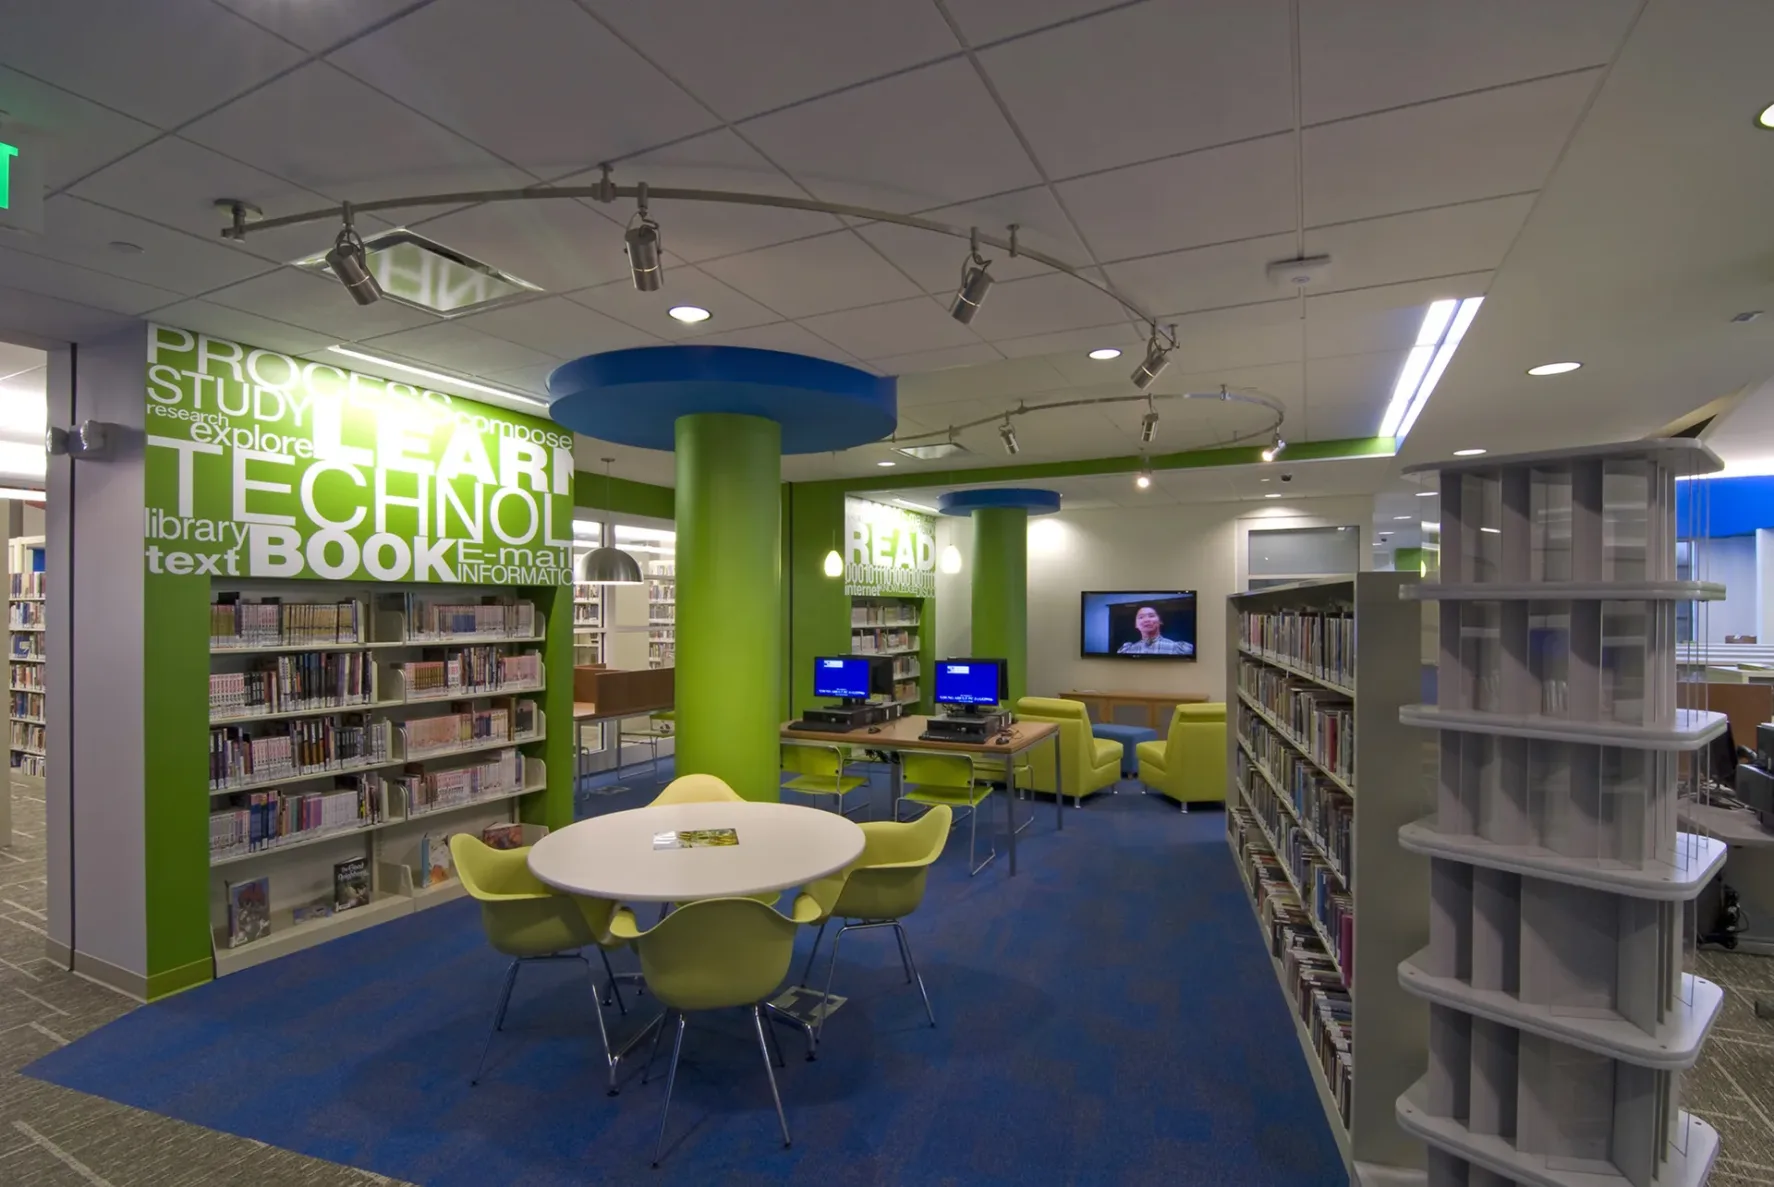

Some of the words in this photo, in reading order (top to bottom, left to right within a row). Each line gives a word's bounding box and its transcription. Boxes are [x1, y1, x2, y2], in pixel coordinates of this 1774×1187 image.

[148, 364, 315, 427] STUDY
[147, 403, 229, 427] research
[453, 411, 572, 450] compose
[190, 424, 315, 459] explore
[145, 507, 249, 551] library
[845, 518, 935, 572] READ
[145, 545, 240, 576] text
[250, 523, 460, 582] BOOK
[458, 538, 573, 569] E-mail
[845, 584, 881, 597] internet
